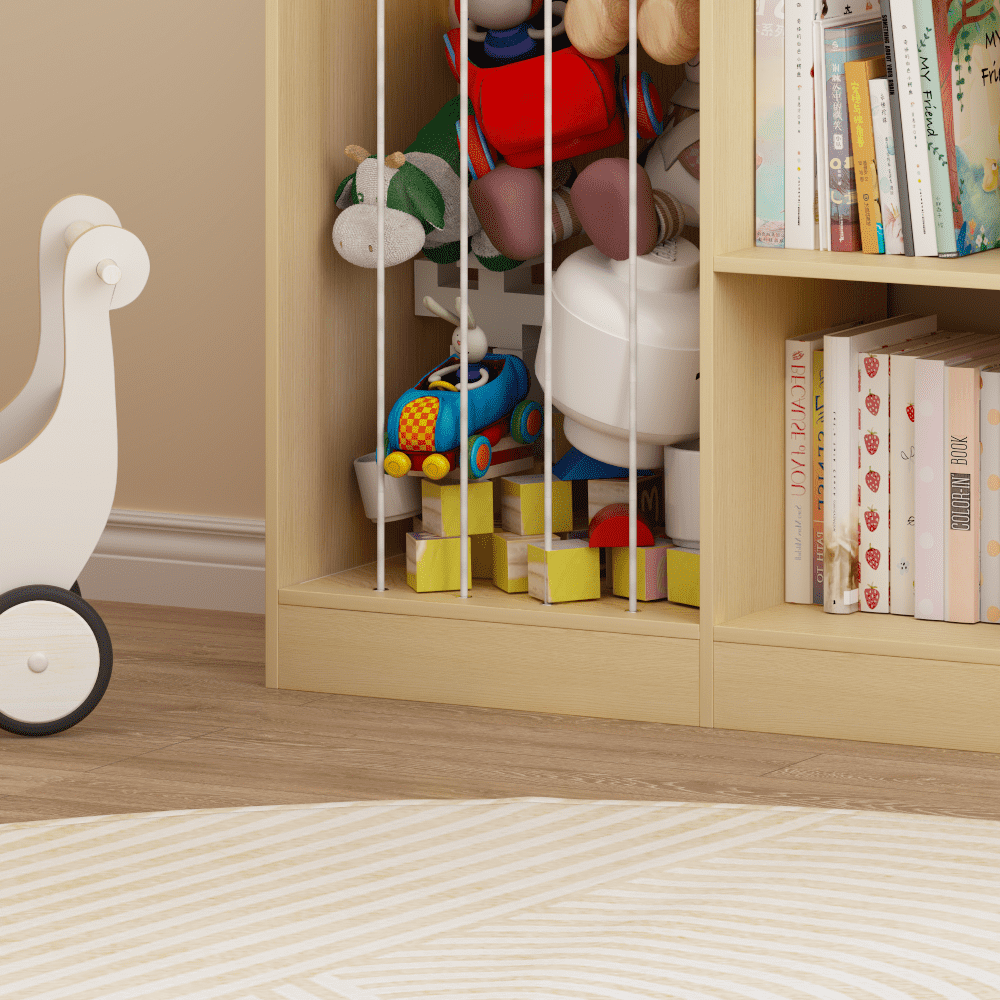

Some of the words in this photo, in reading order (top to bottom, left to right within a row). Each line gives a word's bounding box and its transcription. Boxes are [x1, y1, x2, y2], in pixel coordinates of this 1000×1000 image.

[919, 55, 931, 82] MY
[922, 89, 939, 138] Friend
[950, 435, 968, 466] BOOK
